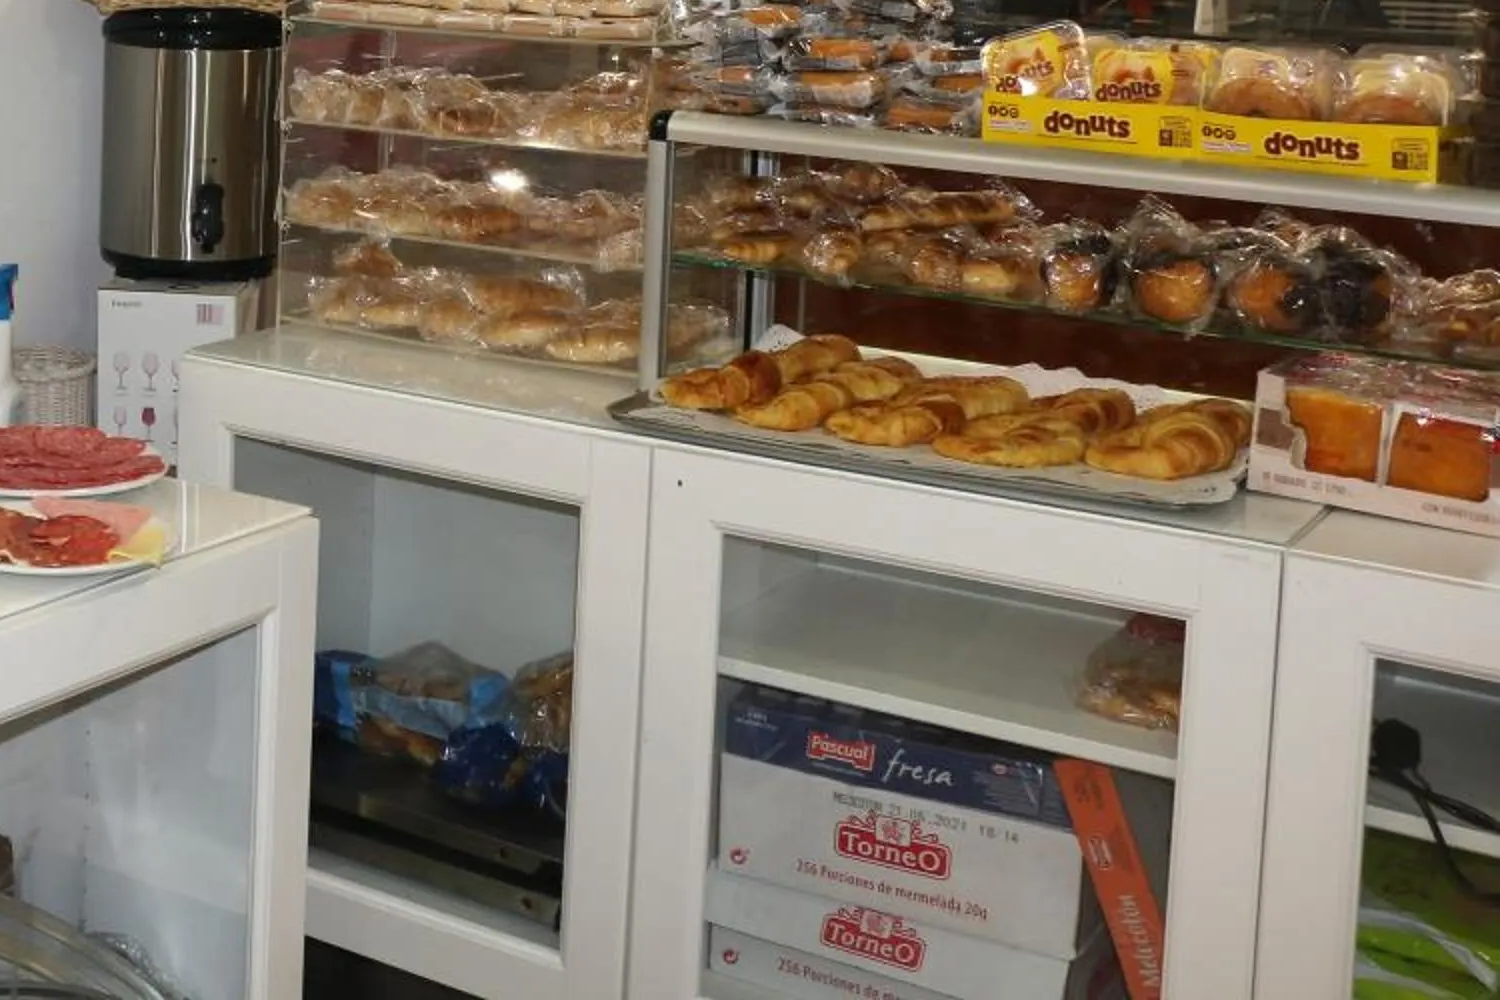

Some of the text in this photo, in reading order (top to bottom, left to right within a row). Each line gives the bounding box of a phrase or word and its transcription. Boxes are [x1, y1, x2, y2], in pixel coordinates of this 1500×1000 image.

[1095, 80, 1163, 102] donuts
[1043, 110, 1131, 139] donuts
[1263, 132, 1361, 161] donuts
[810, 734, 870, 760] Pascual
[881, 748, 954, 786] fresa
[821, 865, 875, 891] Porciones
[877, 880, 893, 895] de
[895, 888, 961, 913] mermelada
[802, 965, 861, 995] Porciones
